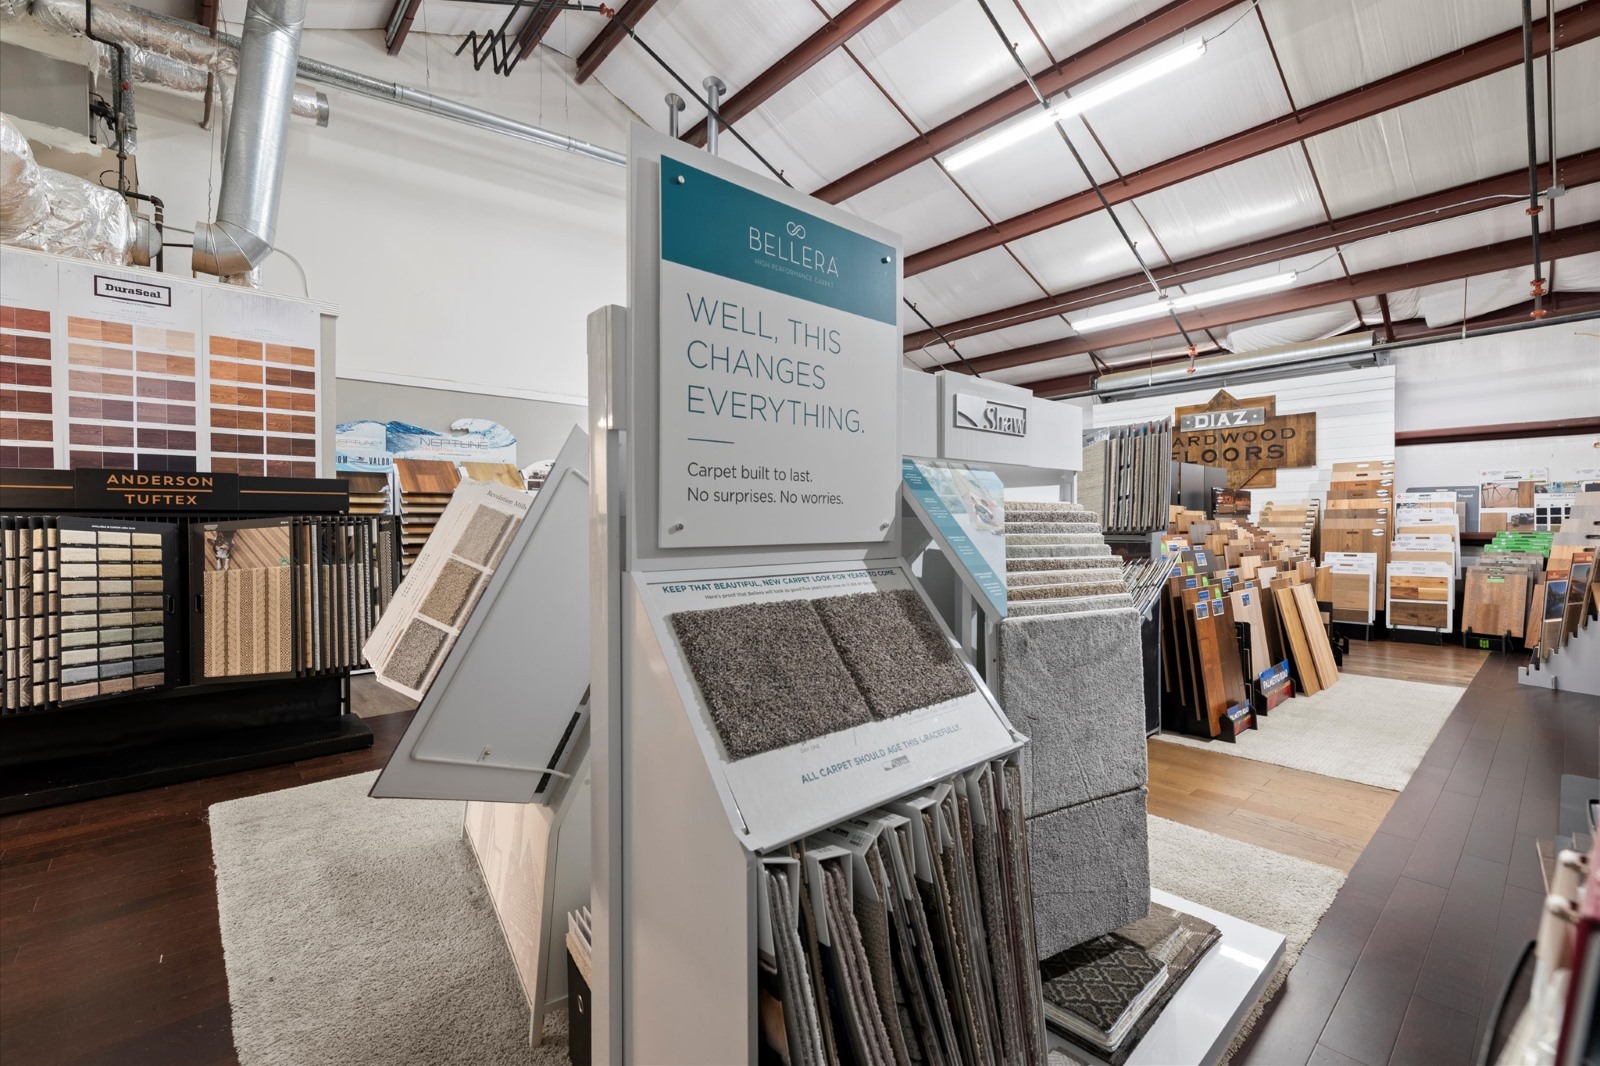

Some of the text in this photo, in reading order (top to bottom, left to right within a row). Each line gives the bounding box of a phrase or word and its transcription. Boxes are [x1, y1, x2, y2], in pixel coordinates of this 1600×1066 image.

[749, 226, 839, 278] BELLERA
[754, 258, 834, 288] HIGH PERFORMANCE CARPET
[104, 283, 162, 299] DuraSeal
[687, 292, 841, 355] WELL, THIS
[687, 339, 826, 390] CHANGES
[687, 385, 865, 434] EVERYTHING.
[1194, 410, 1248, 429] DIAZ
[983, 406, 1026, 435] Shaw
[420, 437, 488, 450] NEPTUNE
[1172, 427, 1296, 448] ARDWOOD
[368, 456, 390, 466] VALOR
[106, 474, 214, 487] ANDERSON
[687, 462, 813, 483] Carpet built to last.
[124, 493, 198, 506] TUFTEX
[687, 487, 844, 505] No surprises. No worries.
[662, 569, 897, 594] KEEP THAT BEAUTIFUL, NEW CARPET LOOK FOR YEARS TO COME.
[800, 724, 962, 785] ALL CARPET SHOULD AGE THIS GRACEFULLY.
